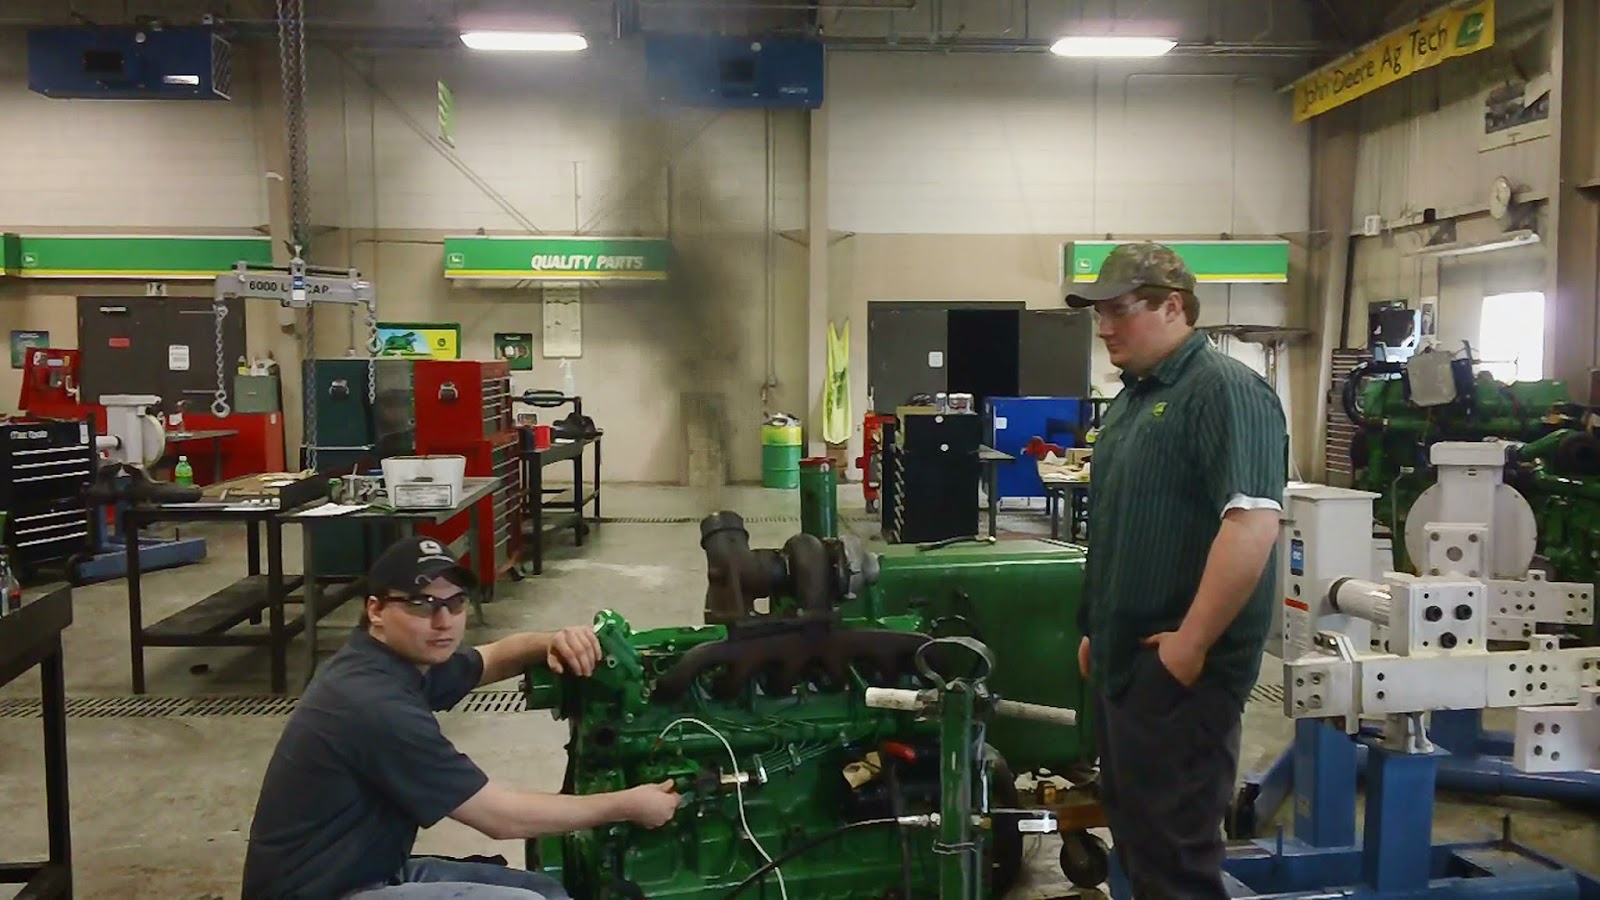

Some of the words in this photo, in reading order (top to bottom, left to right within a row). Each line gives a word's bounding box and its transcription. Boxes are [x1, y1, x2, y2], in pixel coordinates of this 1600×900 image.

[1303, 80, 1329, 113] John
[1333, 60, 1374, 95] Deere
[1381, 47, 1402, 75] Ag
[1409, 23, 1448, 58] Tech
[531, 254, 593, 271] QUALITY
[596, 255, 644, 270] PARTS
[249, 280, 277, 292] 6000
